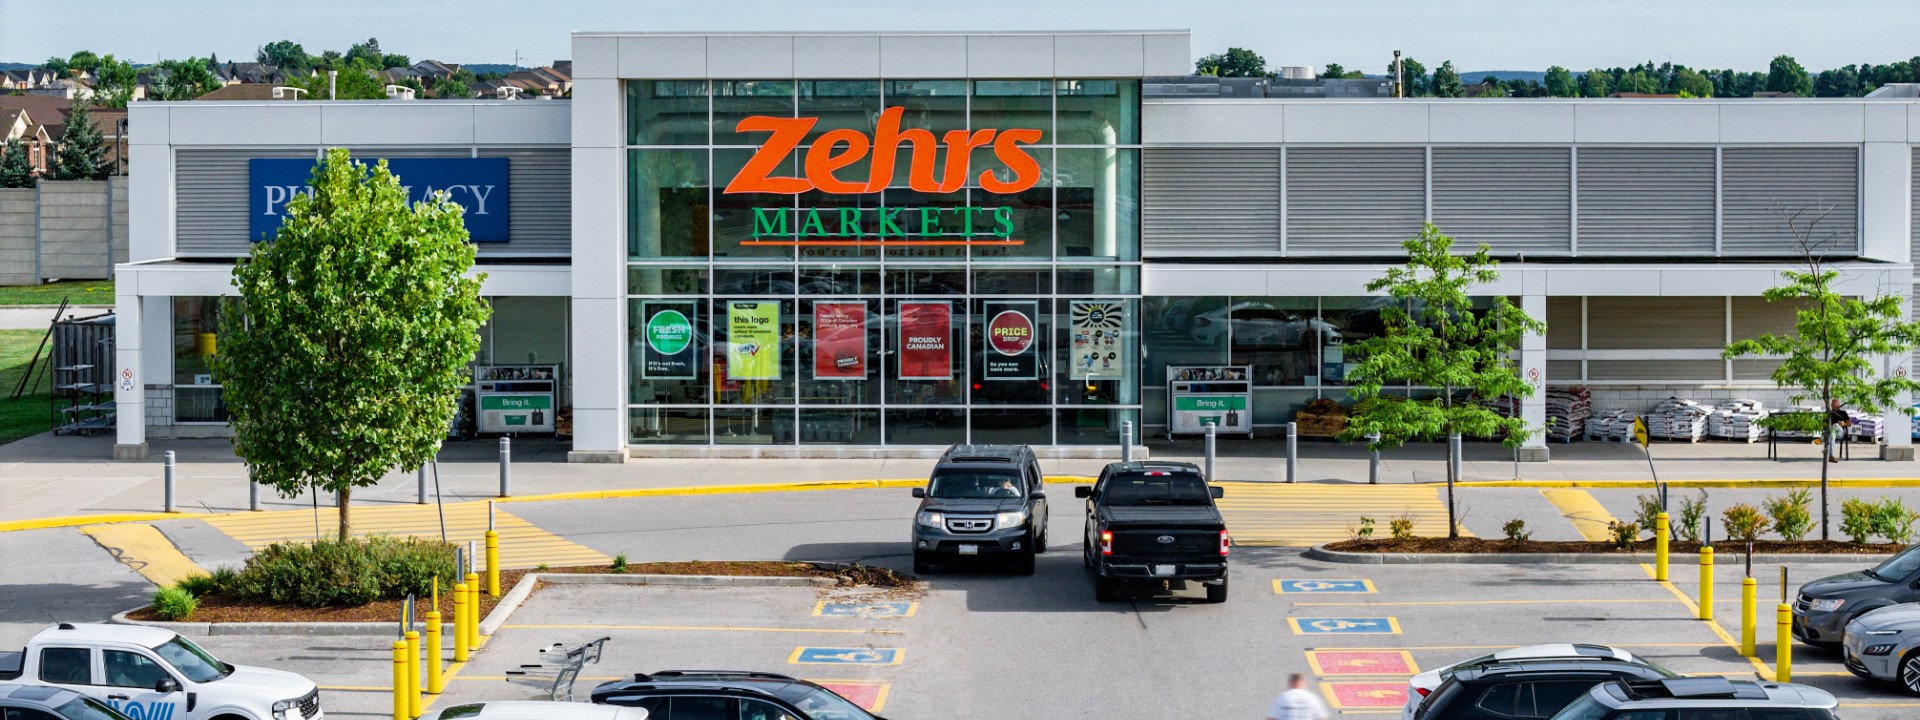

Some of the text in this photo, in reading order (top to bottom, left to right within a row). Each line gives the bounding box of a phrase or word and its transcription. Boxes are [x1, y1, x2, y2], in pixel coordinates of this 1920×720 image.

[723, 107, 1042, 194] Zehrs
[751, 206, 1015, 237] MARKETS
[751, 315, 769, 325] logo
[653, 325, 685, 334] FRESH
[994, 327, 1028, 336] PRICE
[502, 399, 522, 407] Bring
[1196, 399, 1217, 408] Bring
